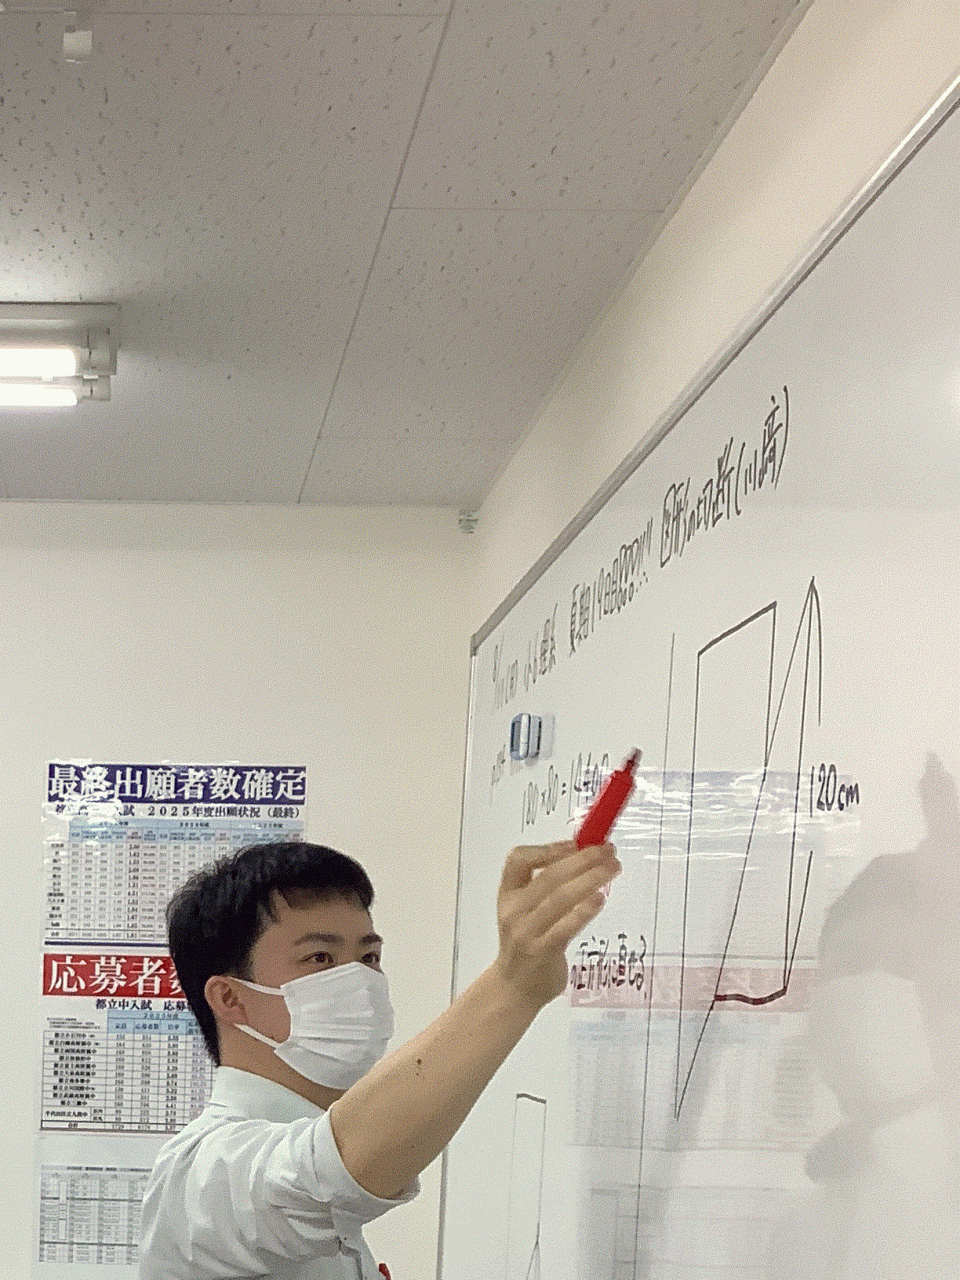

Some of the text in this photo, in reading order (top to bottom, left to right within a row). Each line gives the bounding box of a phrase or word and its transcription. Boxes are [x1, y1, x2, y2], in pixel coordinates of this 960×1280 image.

[49, 765, 307, 803] 最終出願者数確定
[809, 763, 860, 820] 120cm
